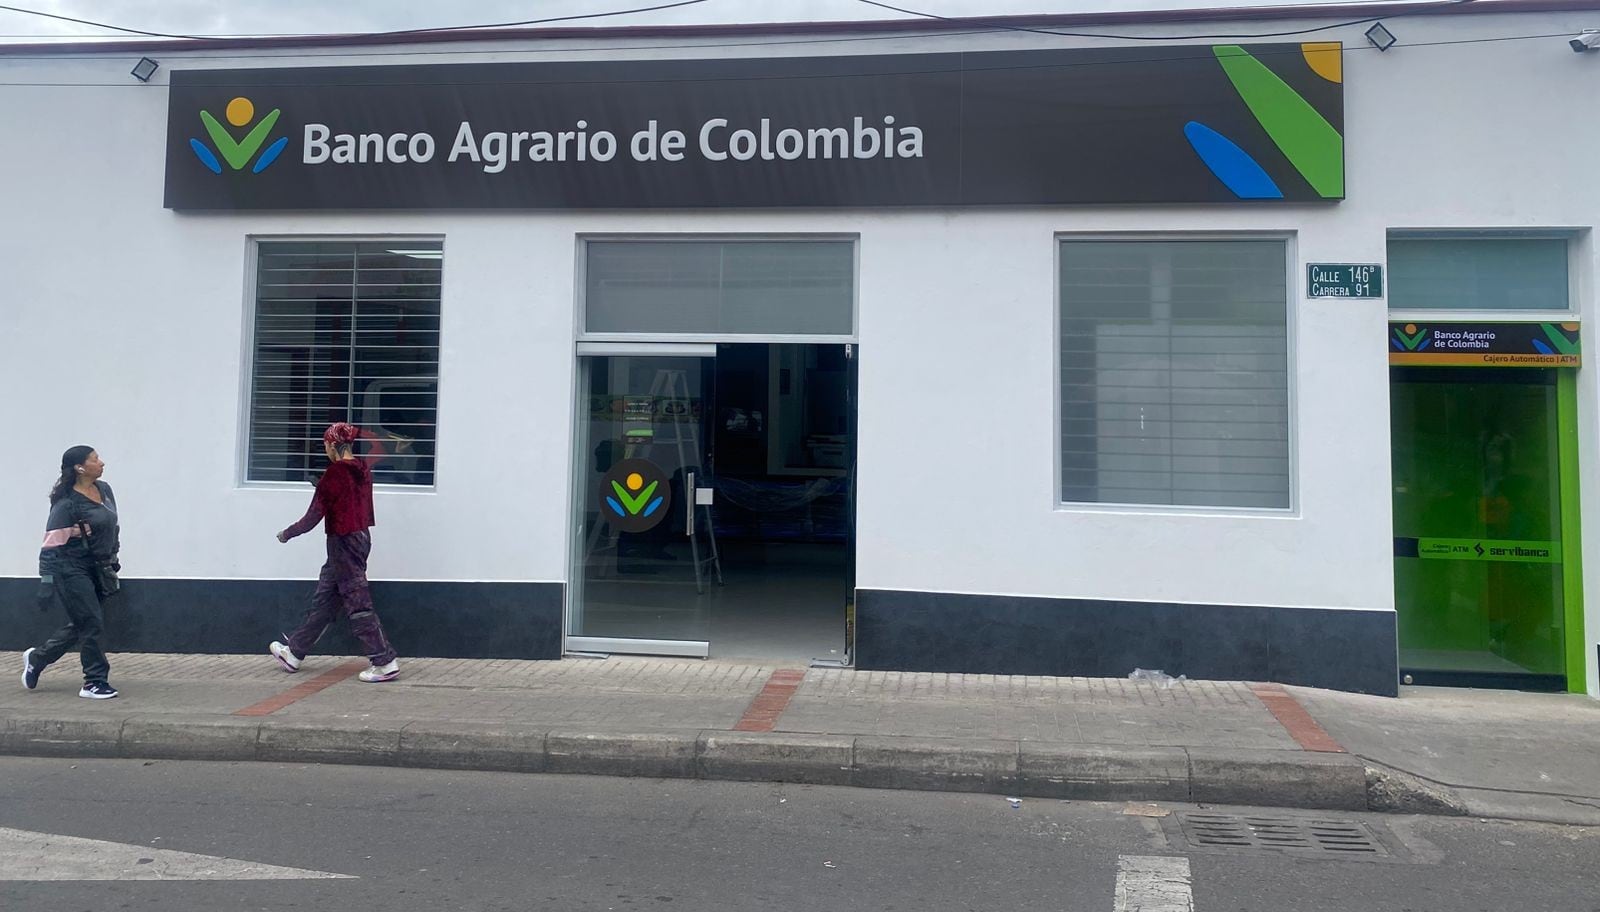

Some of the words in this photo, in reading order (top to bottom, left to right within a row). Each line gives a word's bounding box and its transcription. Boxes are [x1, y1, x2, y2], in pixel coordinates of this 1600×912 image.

[302, 123, 435, 163] Banco
[448, 120, 617, 173] Agrario
[630, 119, 686, 161] de
[698, 116, 924, 161] Colombia
[1355, 283, 1370, 296] 91
[1434, 330, 1461, 339] Banco
[1462, 331, 1496, 341] Agrario
[1434, 340, 1446, 348] de
[1447, 340, 1490, 349] Colombia
[1483, 355, 1508, 364] Cajero
[1510, 355, 1555, 363] Automático
[1452, 545, 1469, 553] ATM
[1490, 546, 1549, 557] servibanca
